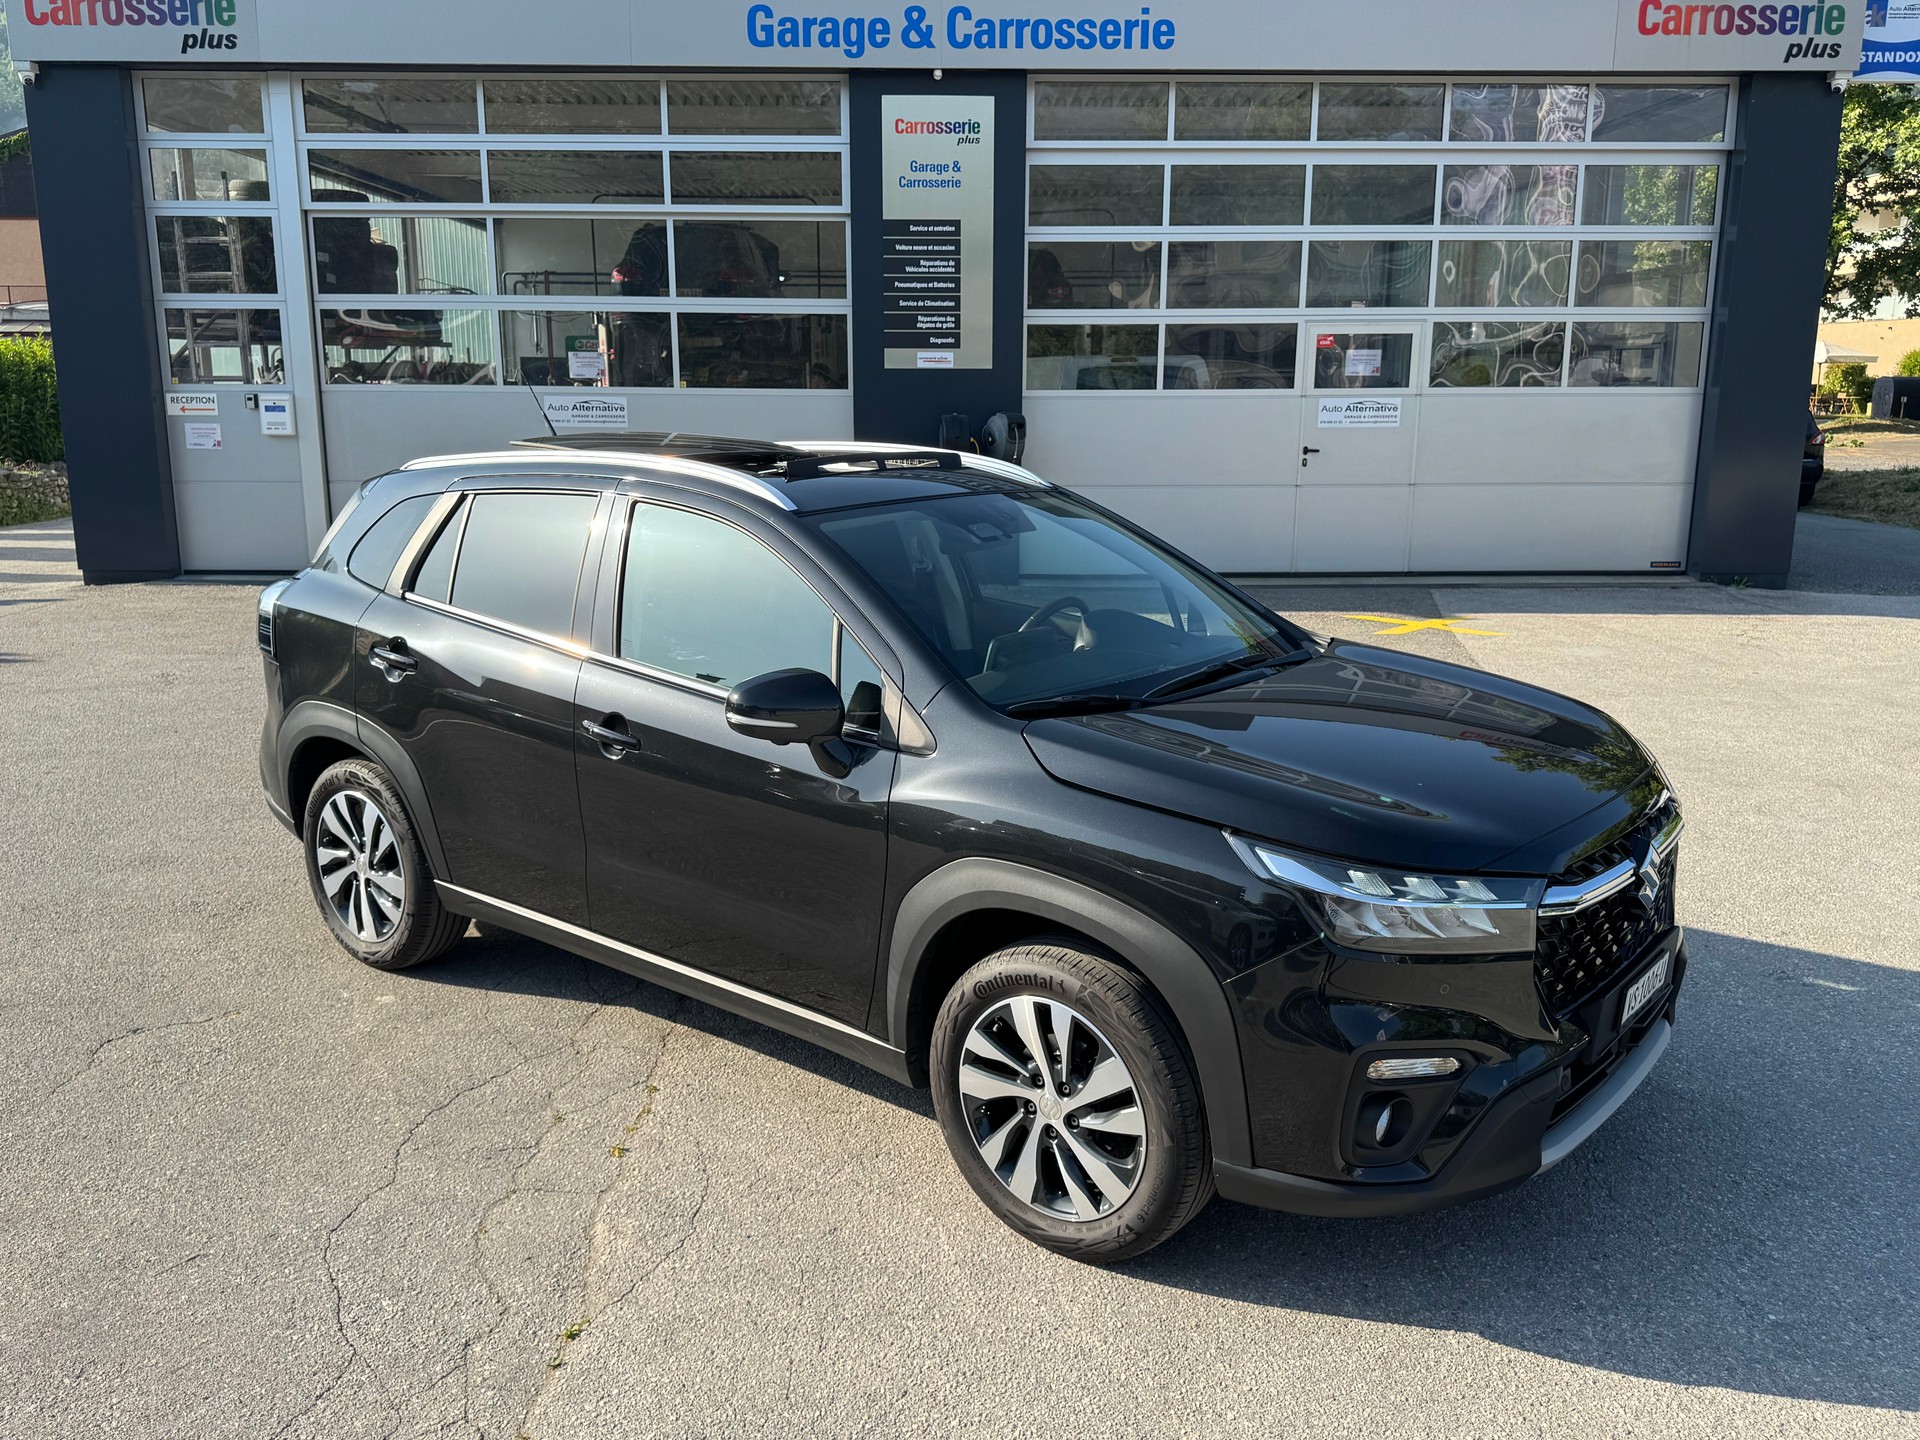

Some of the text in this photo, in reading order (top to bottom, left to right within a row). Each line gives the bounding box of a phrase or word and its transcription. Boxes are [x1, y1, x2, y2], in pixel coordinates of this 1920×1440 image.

[24, 0, 237, 26] Carrosserie
[1637, 0, 1846, 36] Carrosserie
[746, 4, 1176, 59] Garage & Carrosserie
[181, 28, 238, 54] plus
[1783, 37, 1842, 63] plus
[895, 118, 981, 134] Carrosserie
[957, 135, 980, 146] plus
[910, 160, 961, 175] Garage &
[898, 176, 961, 188] Carrosserie
[170, 396, 215, 404] RECEPTION
[547, 403, 625, 412] Auto Alternative
[1320, 404, 1399, 413] Auto Alternative
[307, 774, 336, 817] Continental
[972, 972, 1054, 1000] Continental
[1136, 1213, 1146, 1224] 6
